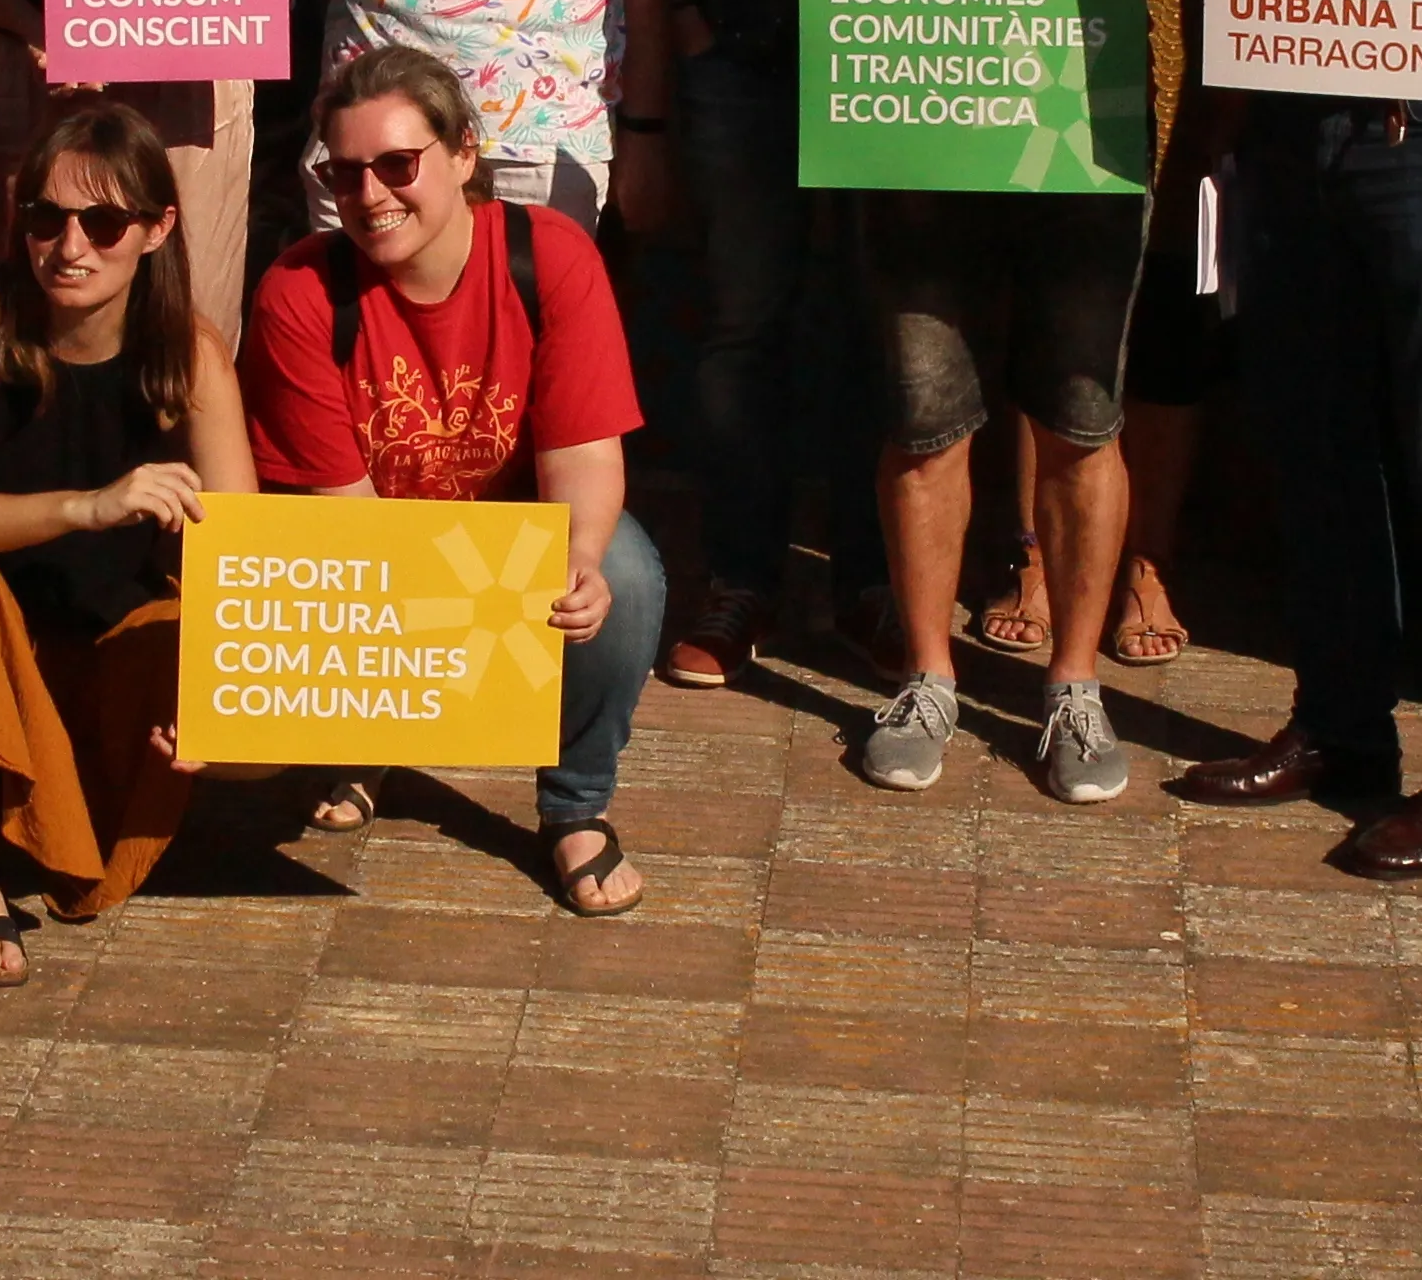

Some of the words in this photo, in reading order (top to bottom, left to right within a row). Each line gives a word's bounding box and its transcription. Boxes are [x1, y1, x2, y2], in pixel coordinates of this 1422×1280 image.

[64, 16, 271, 48] CONSCIENT
[829, 11, 1108, 48] COMUNITÀRIES
[831, 54, 838, 83] I
[847, 51, 1043, 86] TRANSICIÓ
[829, 89, 1039, 127] ECOLÒGICA
[217, 555, 370, 592] ESPORT
[380, 562, 390, 593] I
[215, 598, 403, 635] CULTURA
[213, 642, 310, 675] COM
[319, 645, 348, 676] A
[357, 646, 469, 679] EINES
[212, 685, 443, 720] COMUNALS
